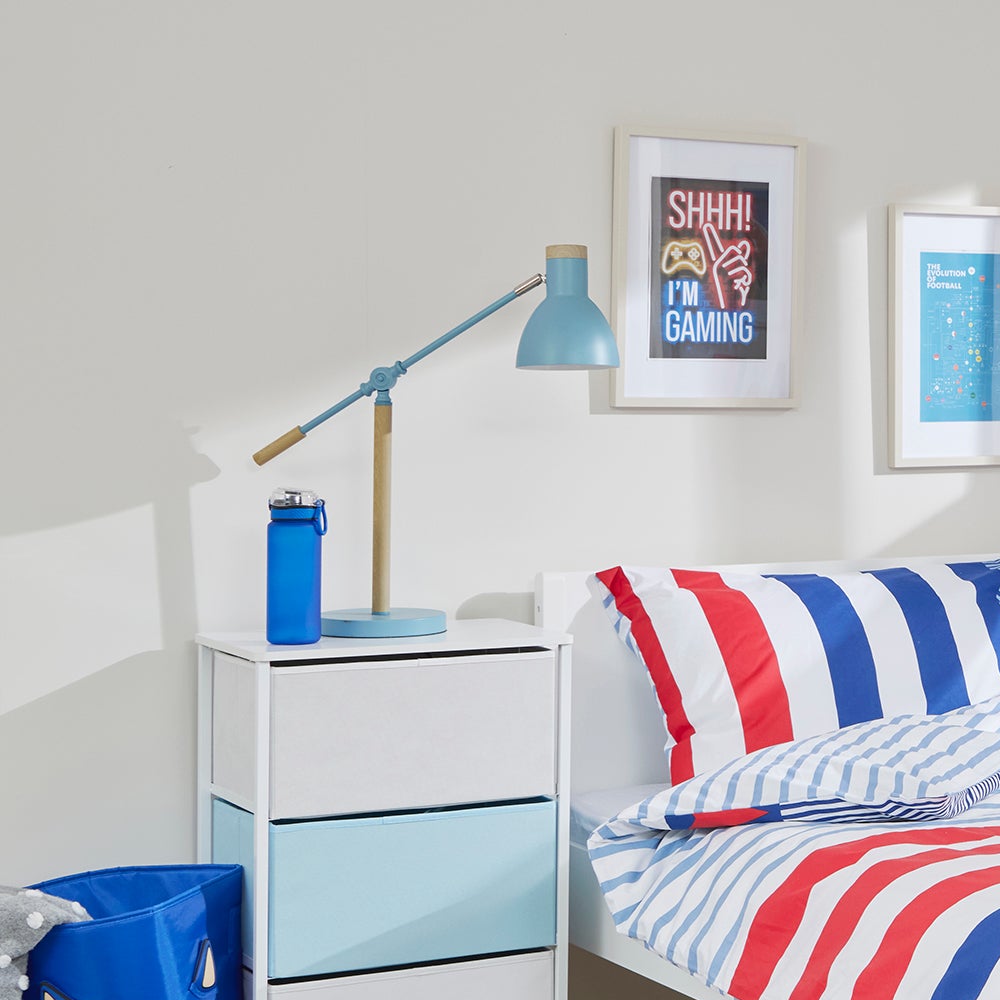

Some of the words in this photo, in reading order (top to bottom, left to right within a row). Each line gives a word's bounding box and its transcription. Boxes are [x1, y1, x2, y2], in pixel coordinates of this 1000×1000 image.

[669, 190, 751, 231] SHHH!
[668, 280, 699, 306] I'M
[665, 310, 753, 343] GAMING
